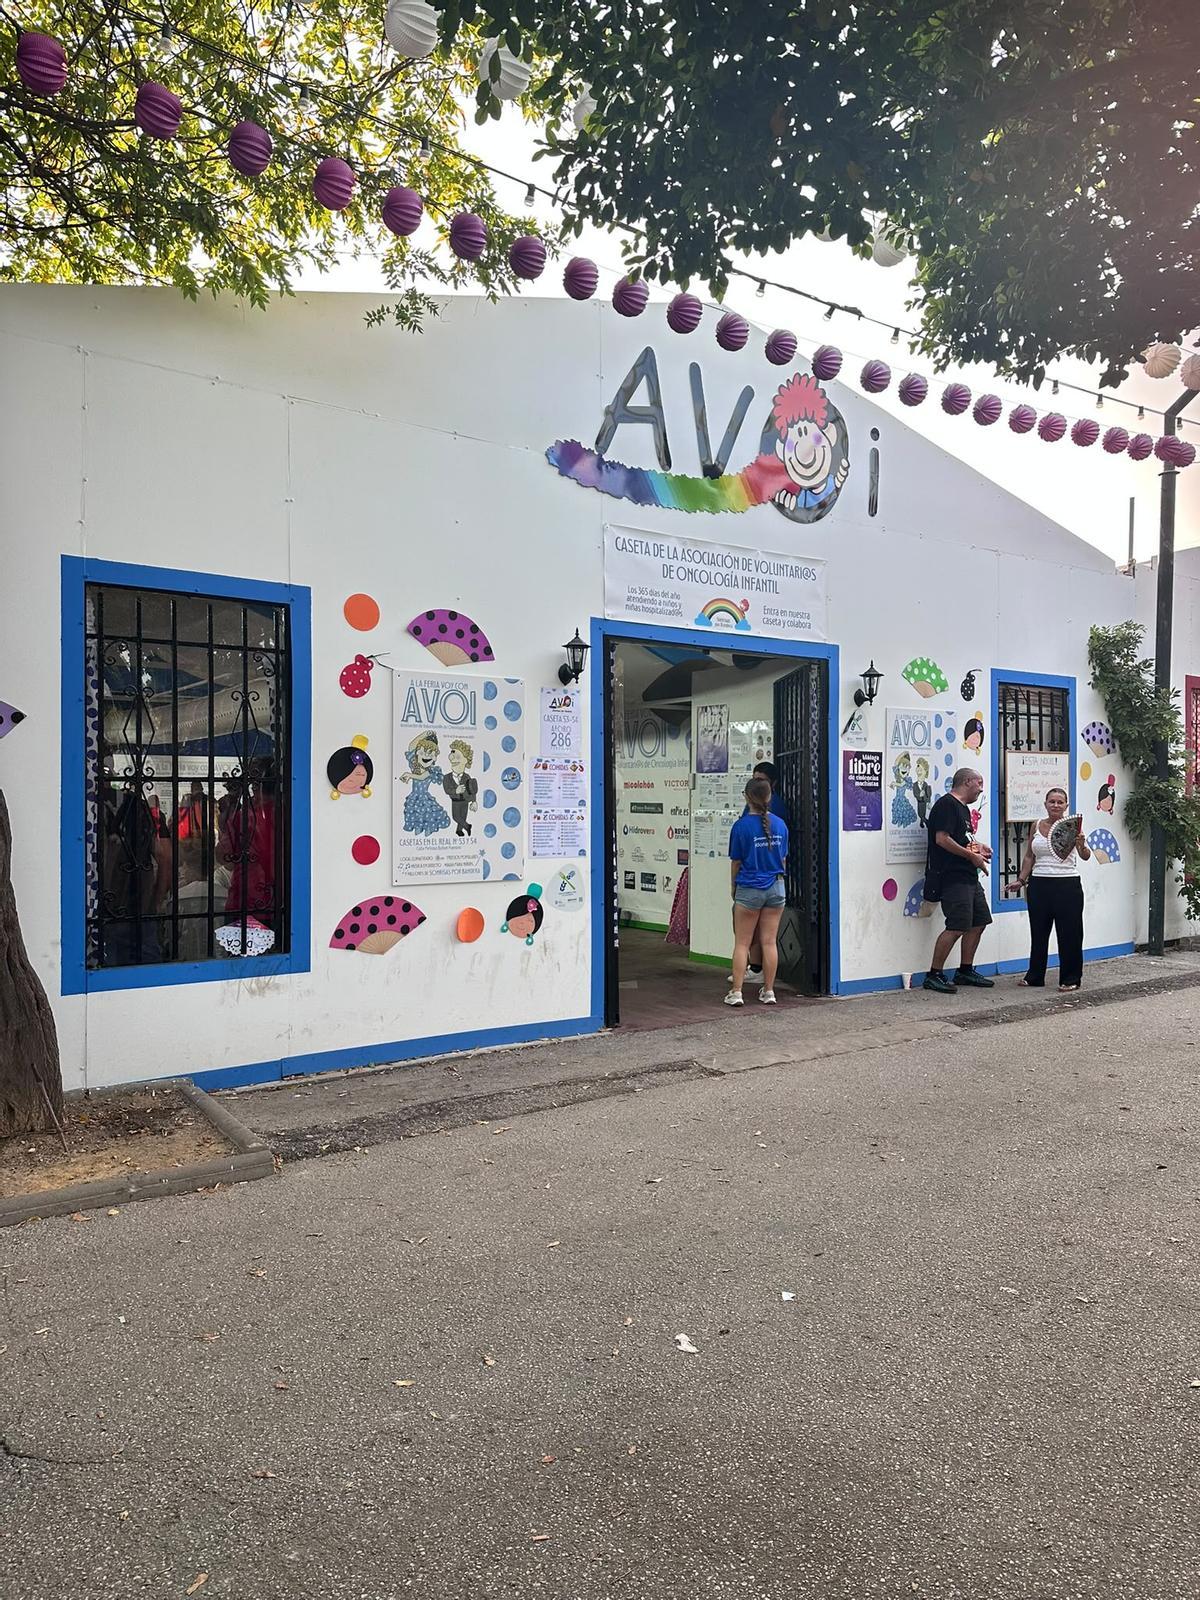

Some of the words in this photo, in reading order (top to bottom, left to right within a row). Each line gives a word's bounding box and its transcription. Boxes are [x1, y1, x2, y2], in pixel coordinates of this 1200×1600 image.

[615, 536, 651, 557] CASETA
[653, 543, 665, 559] DE
[667, 545, 678, 561] LA
[680, 548, 740, 570] ASOCIACIÓN
[742, 558, 752, 572] DE
[754, 560, 817, 581] VOLUNTARI@S
[662, 563, 674, 579] DE
[676, 566, 739, 589] ONCOLOGÍA
[741, 576, 780, 594] INFANTIL
[627, 585, 637, 594] Los
[638, 586, 649, 596] 365
[661, 591, 669, 599] del
[670, 592, 680, 600] año
[625, 604, 641, 612] niñas
[626, 595, 657, 606] atendiendo
[663, 599, 678, 608] niños
[763, 605, 779, 616] Entra
[788, 610, 811, 620] nuestra
[763, 617, 782, 626] caseta
[787, 619, 812, 629] colabora
[401, 687, 476, 725] AVOI
[551, 732, 571, 747] 286
[891, 719, 932, 747] AVOI
[548, 763, 569, 771] COMIDAS
[848, 757, 881, 775] libre
[399, 839, 422, 847] CASETAS
[423, 838, 431, 846] EN
